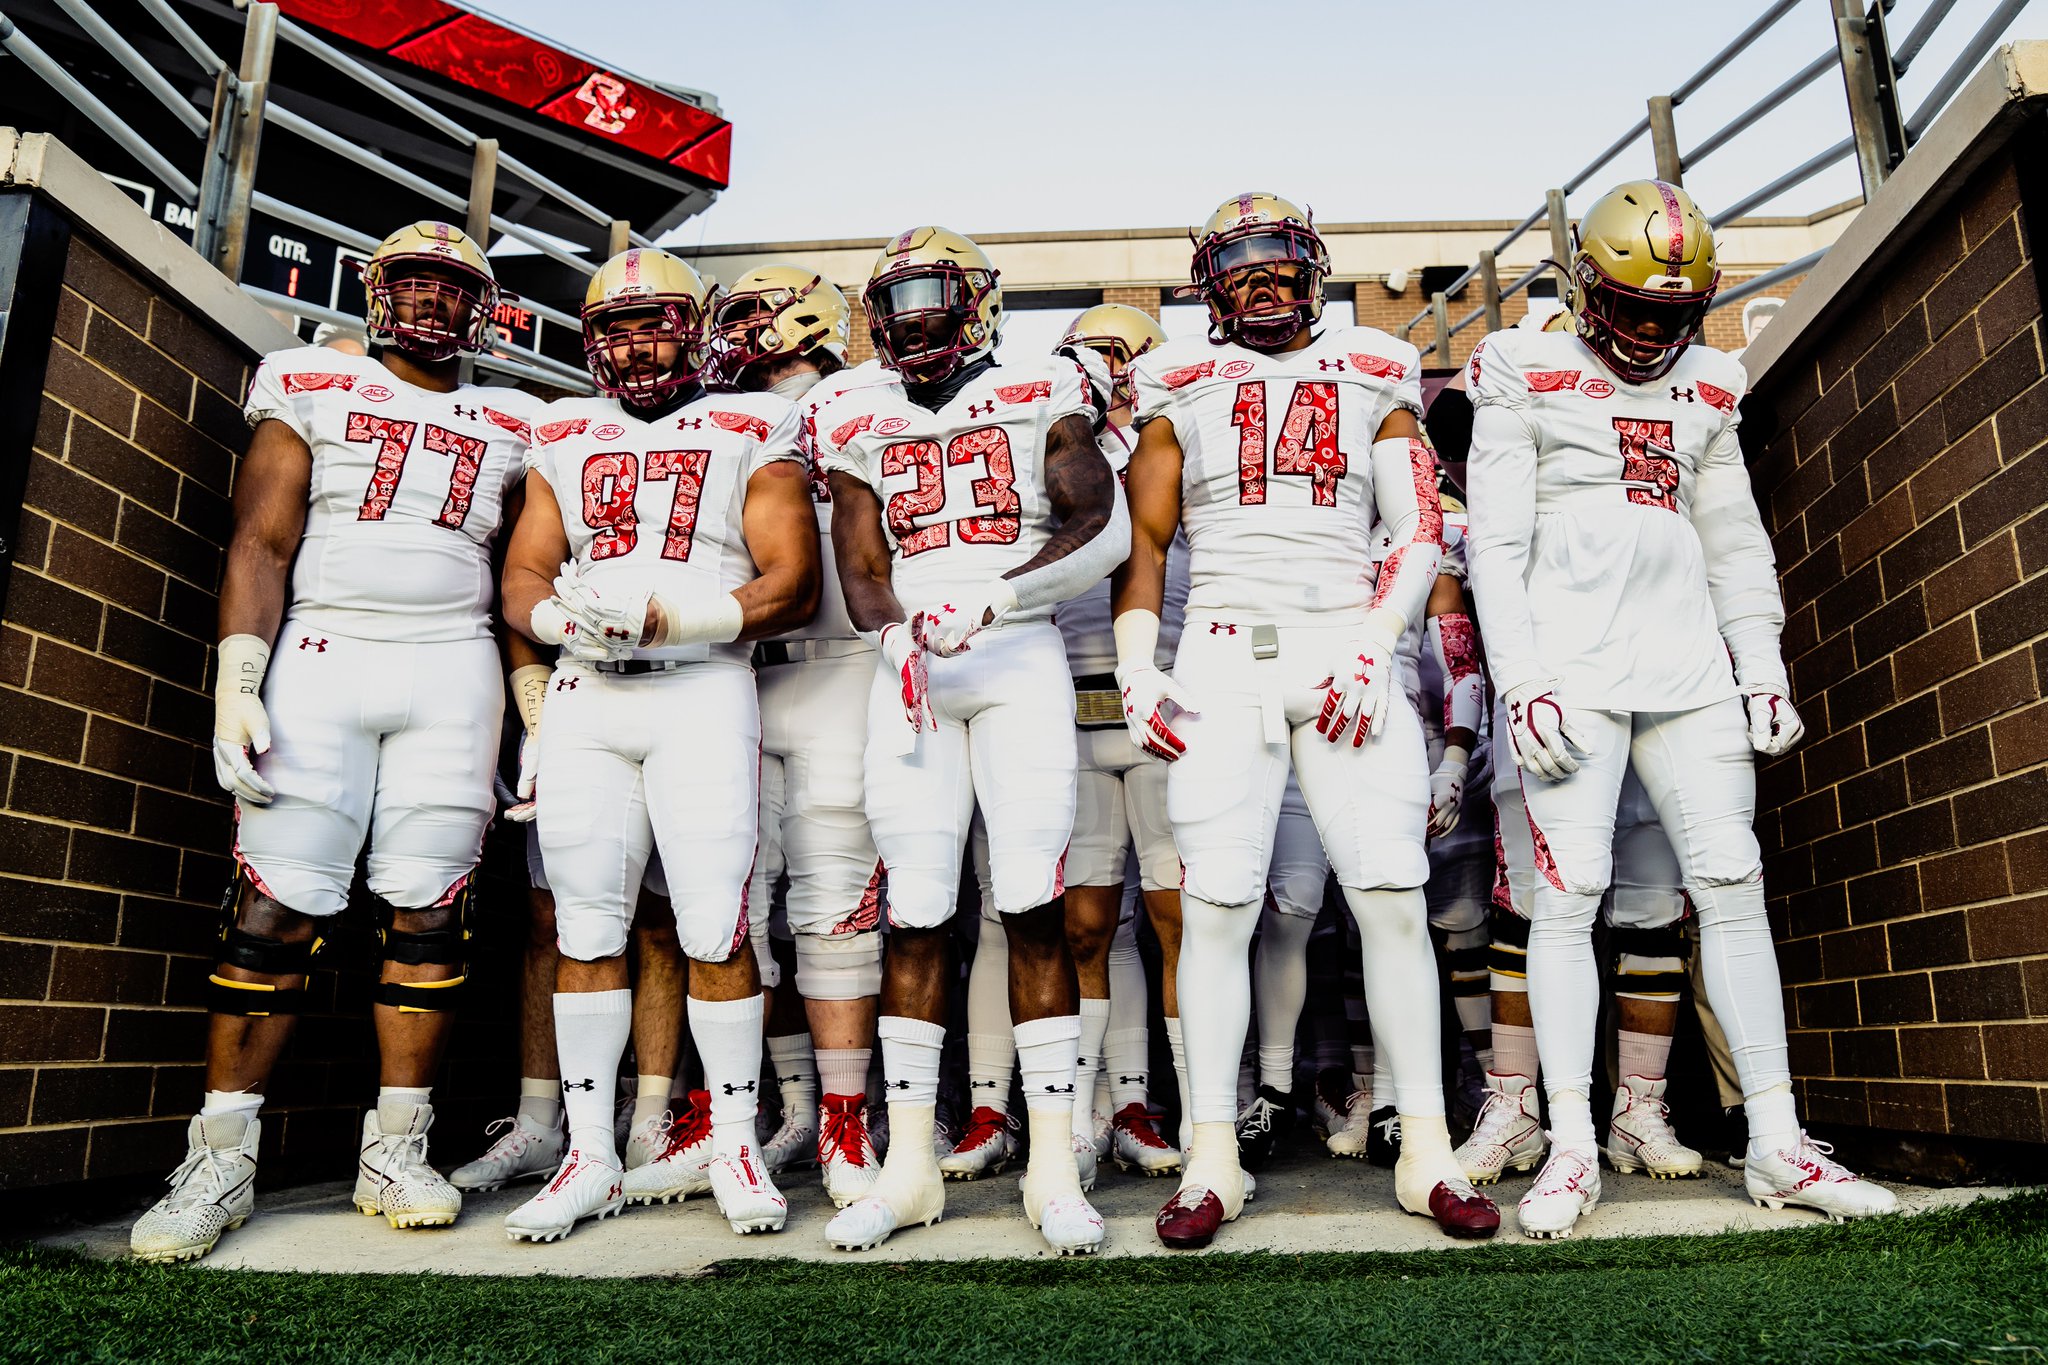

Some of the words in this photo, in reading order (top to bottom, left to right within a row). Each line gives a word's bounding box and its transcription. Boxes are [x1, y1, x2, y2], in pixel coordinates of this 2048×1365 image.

[1238, 215, 1259, 225] ACC
[269, 234, 311, 265] QTR.
[431, 246, 452, 254] ACC
[890, 259, 910, 269] ACC
[288, 267, 299, 297] 1
[619, 286, 641, 294] ACC
[1660, 280, 1684, 289] ACC
[490, 303, 532, 331] AME
[1225, 363, 1249, 372] ACC
[365, 388, 388, 397] ACC
[881, 420, 906, 430] ACC
[1231, 380, 1348, 507] 14
[345, 411, 488, 531] 77
[1612, 417, 1680, 514] 5
[881, 426, 1022, 559] 23
[581, 450, 712, 563] 97
